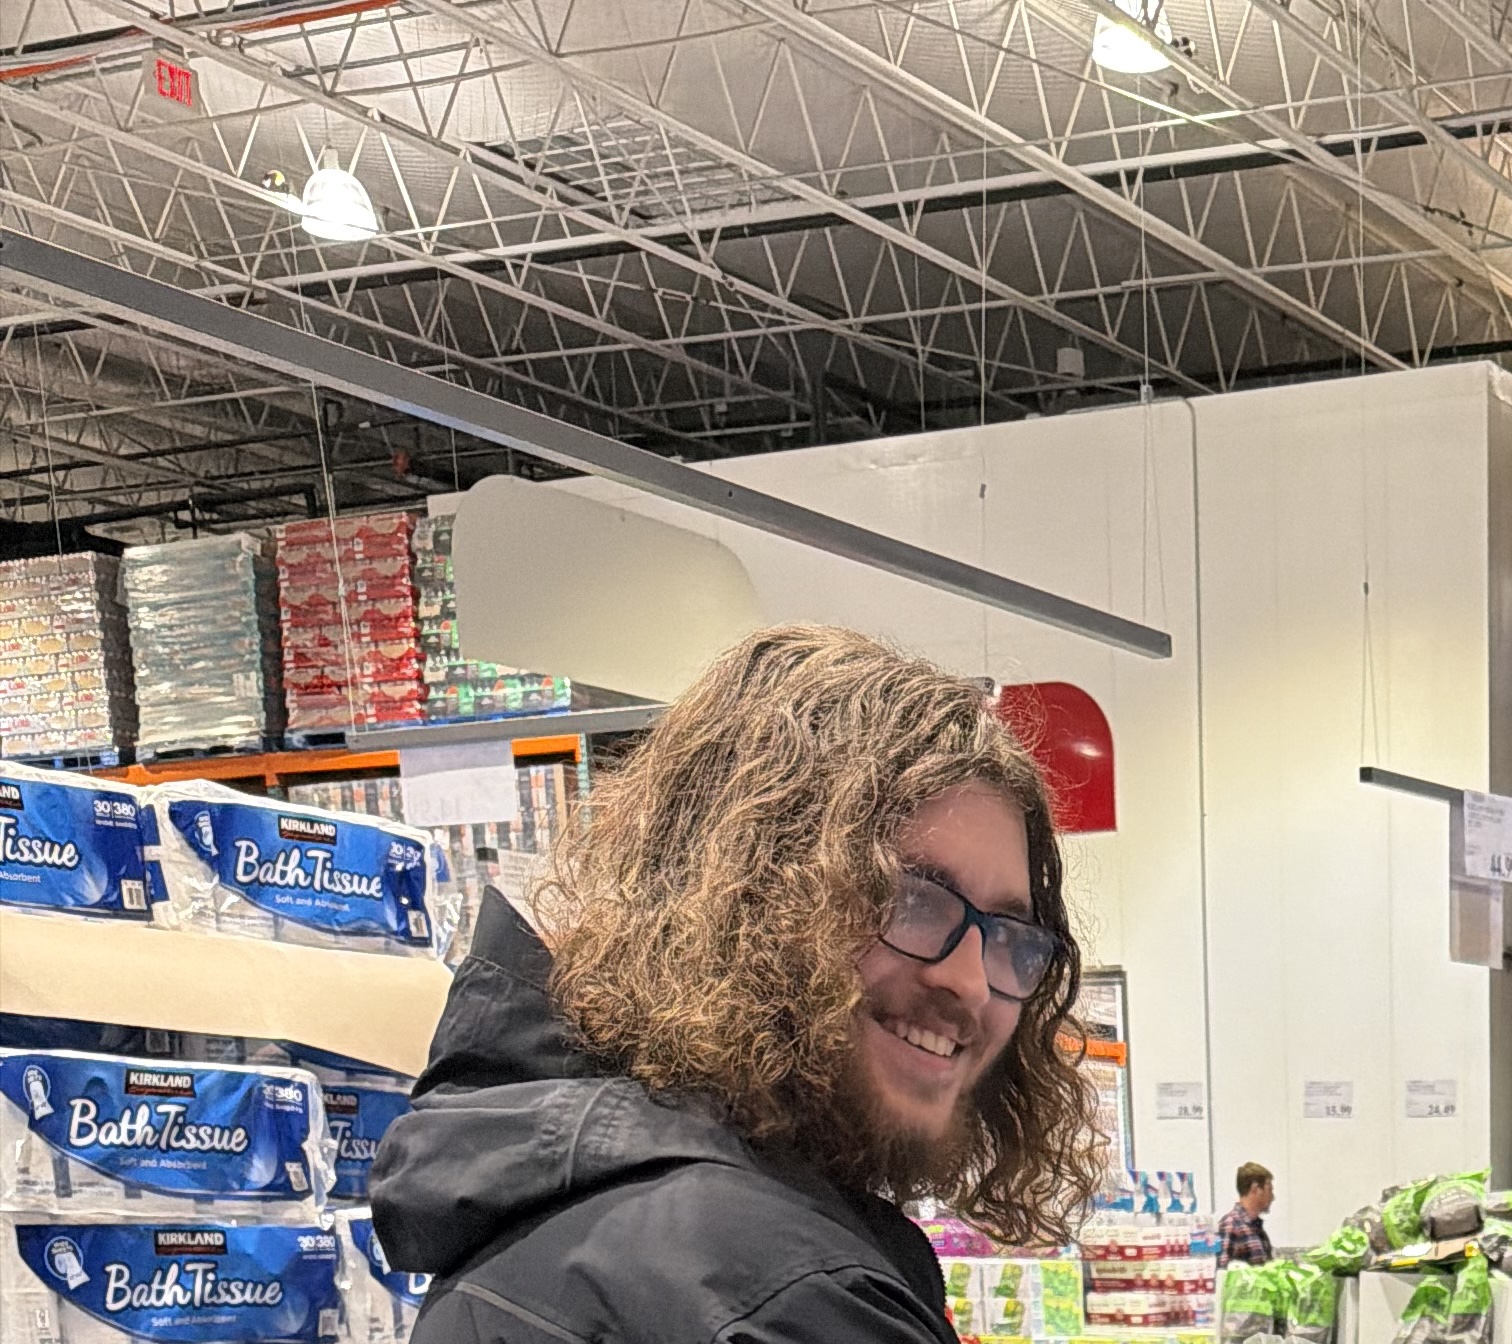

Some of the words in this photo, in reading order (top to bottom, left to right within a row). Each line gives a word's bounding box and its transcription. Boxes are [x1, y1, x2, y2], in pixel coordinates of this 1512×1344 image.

[93, 800, 111, 814] 30
[113, 801, 137, 817] 380
[281, 818, 336, 836] KIRKLAND
[234, 840, 311, 887] Bath
[307, 850, 383, 897] Tissue
[129, 1073, 192, 1088] KIRKLAND
[69, 1099, 159, 1147] Bath
[157, 1104, 249, 1153] Tissue
[330, 1121, 379, 1160] Tissu
[157, 1233, 224, 1247] KIRKLAND
[104, 1263, 190, 1311] Bath
[185, 1262, 283, 1306] Tissue
